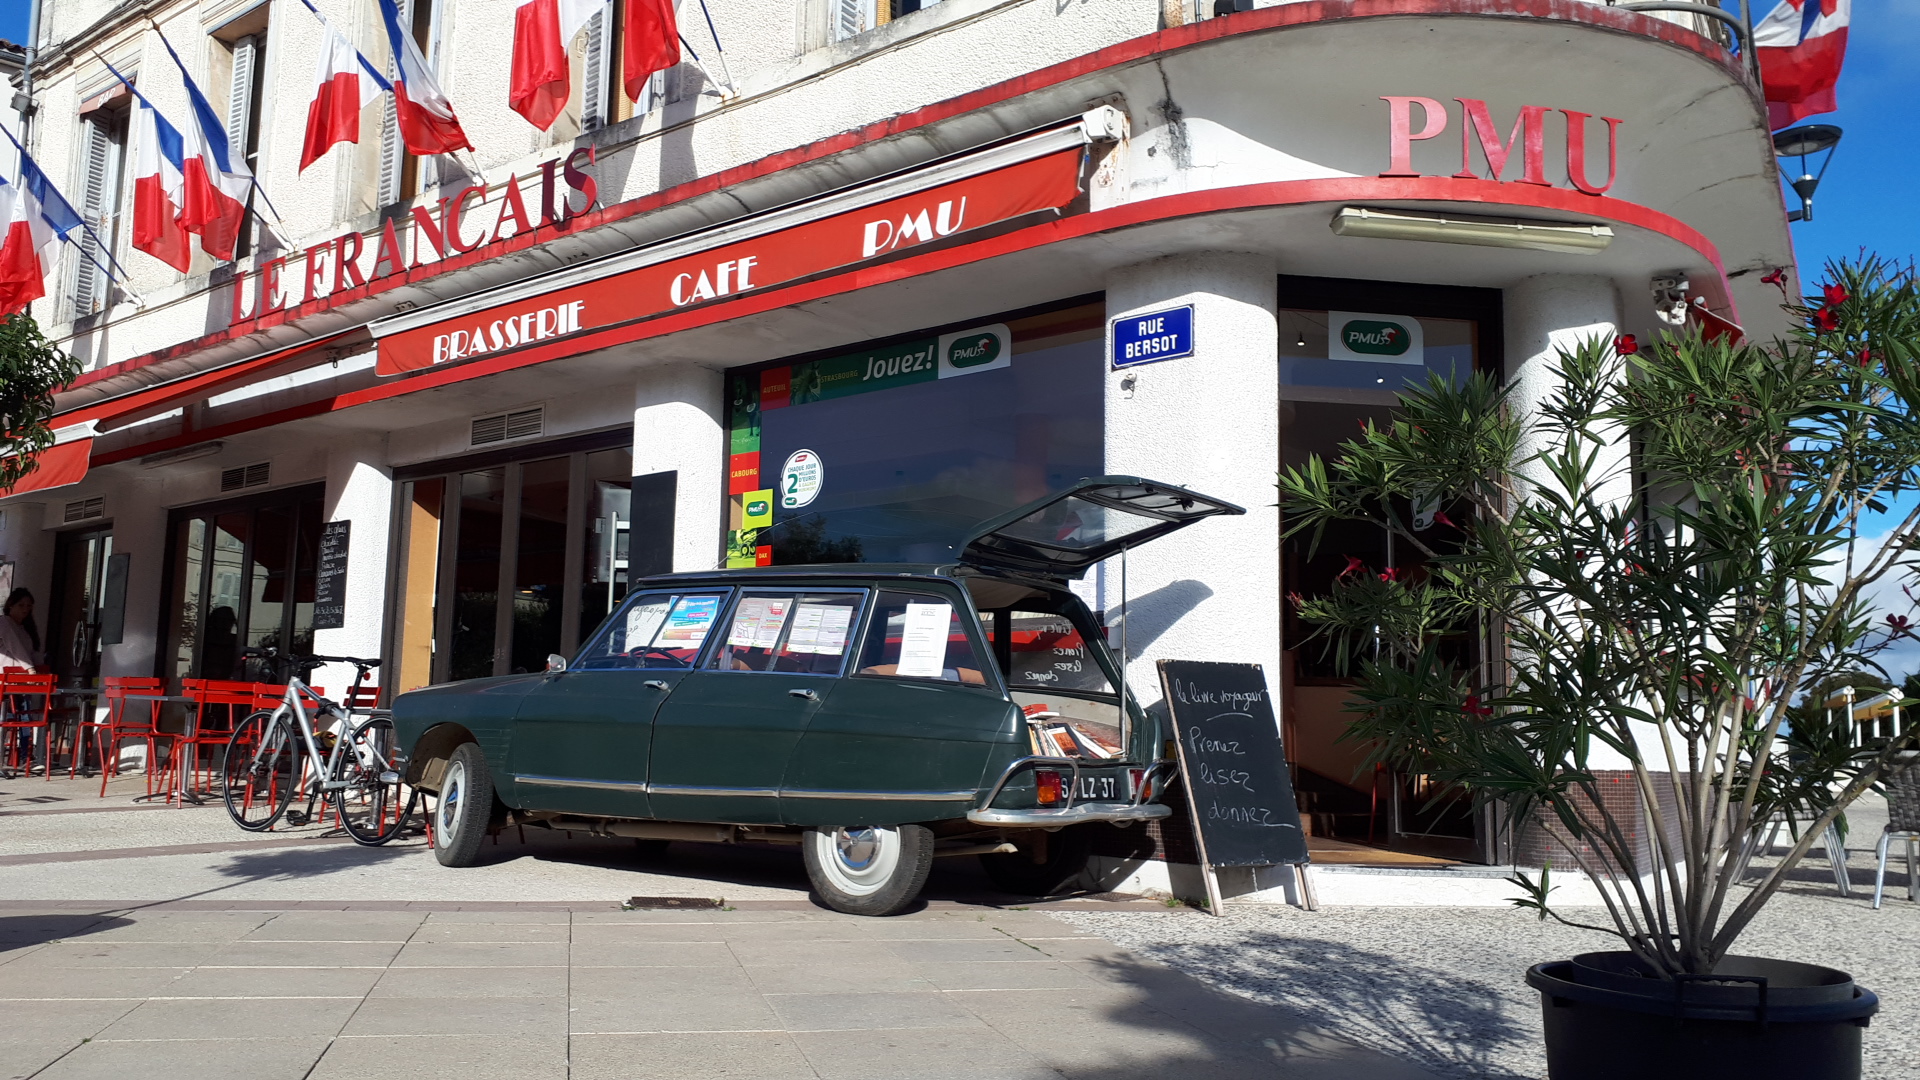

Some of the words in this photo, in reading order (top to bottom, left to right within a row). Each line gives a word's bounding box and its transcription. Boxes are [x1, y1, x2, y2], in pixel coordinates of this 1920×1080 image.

[1379, 96, 1624, 195] PMU
[228, 254, 287, 327] LE
[300, 143, 598, 303] FRANCAIS
[432, 300, 585, 365] BRASSERIE
[670, 256, 758, 306] CAFE
[863, 196, 967, 258] PMU
[1138, 317, 1165, 336] RUE
[1348, 331, 1381, 345] PMU
[953, 346, 979, 361] PMU
[1125, 334, 1178, 359] BERSOT
[863, 344, 935, 381] Jouez!
[820, 370, 859, 384] STRASBOURG
[763, 384, 787, 394] AUTEUIL
[731, 468, 758, 478] CABOURG
[788, 465, 805, 473] CHAQUE
[787, 473, 799, 495] 2
[1189, 682, 1218, 703] livre
[1220, 688, 1265, 711] voyageur
[1189, 726, 1246, 755] Prenez
[1080, 777, 1097, 799] LZ
[1100, 777, 1115, 799] 37
[1200, 762, 1255, 793] lisez
[1208, 800, 1294, 829] donnez
